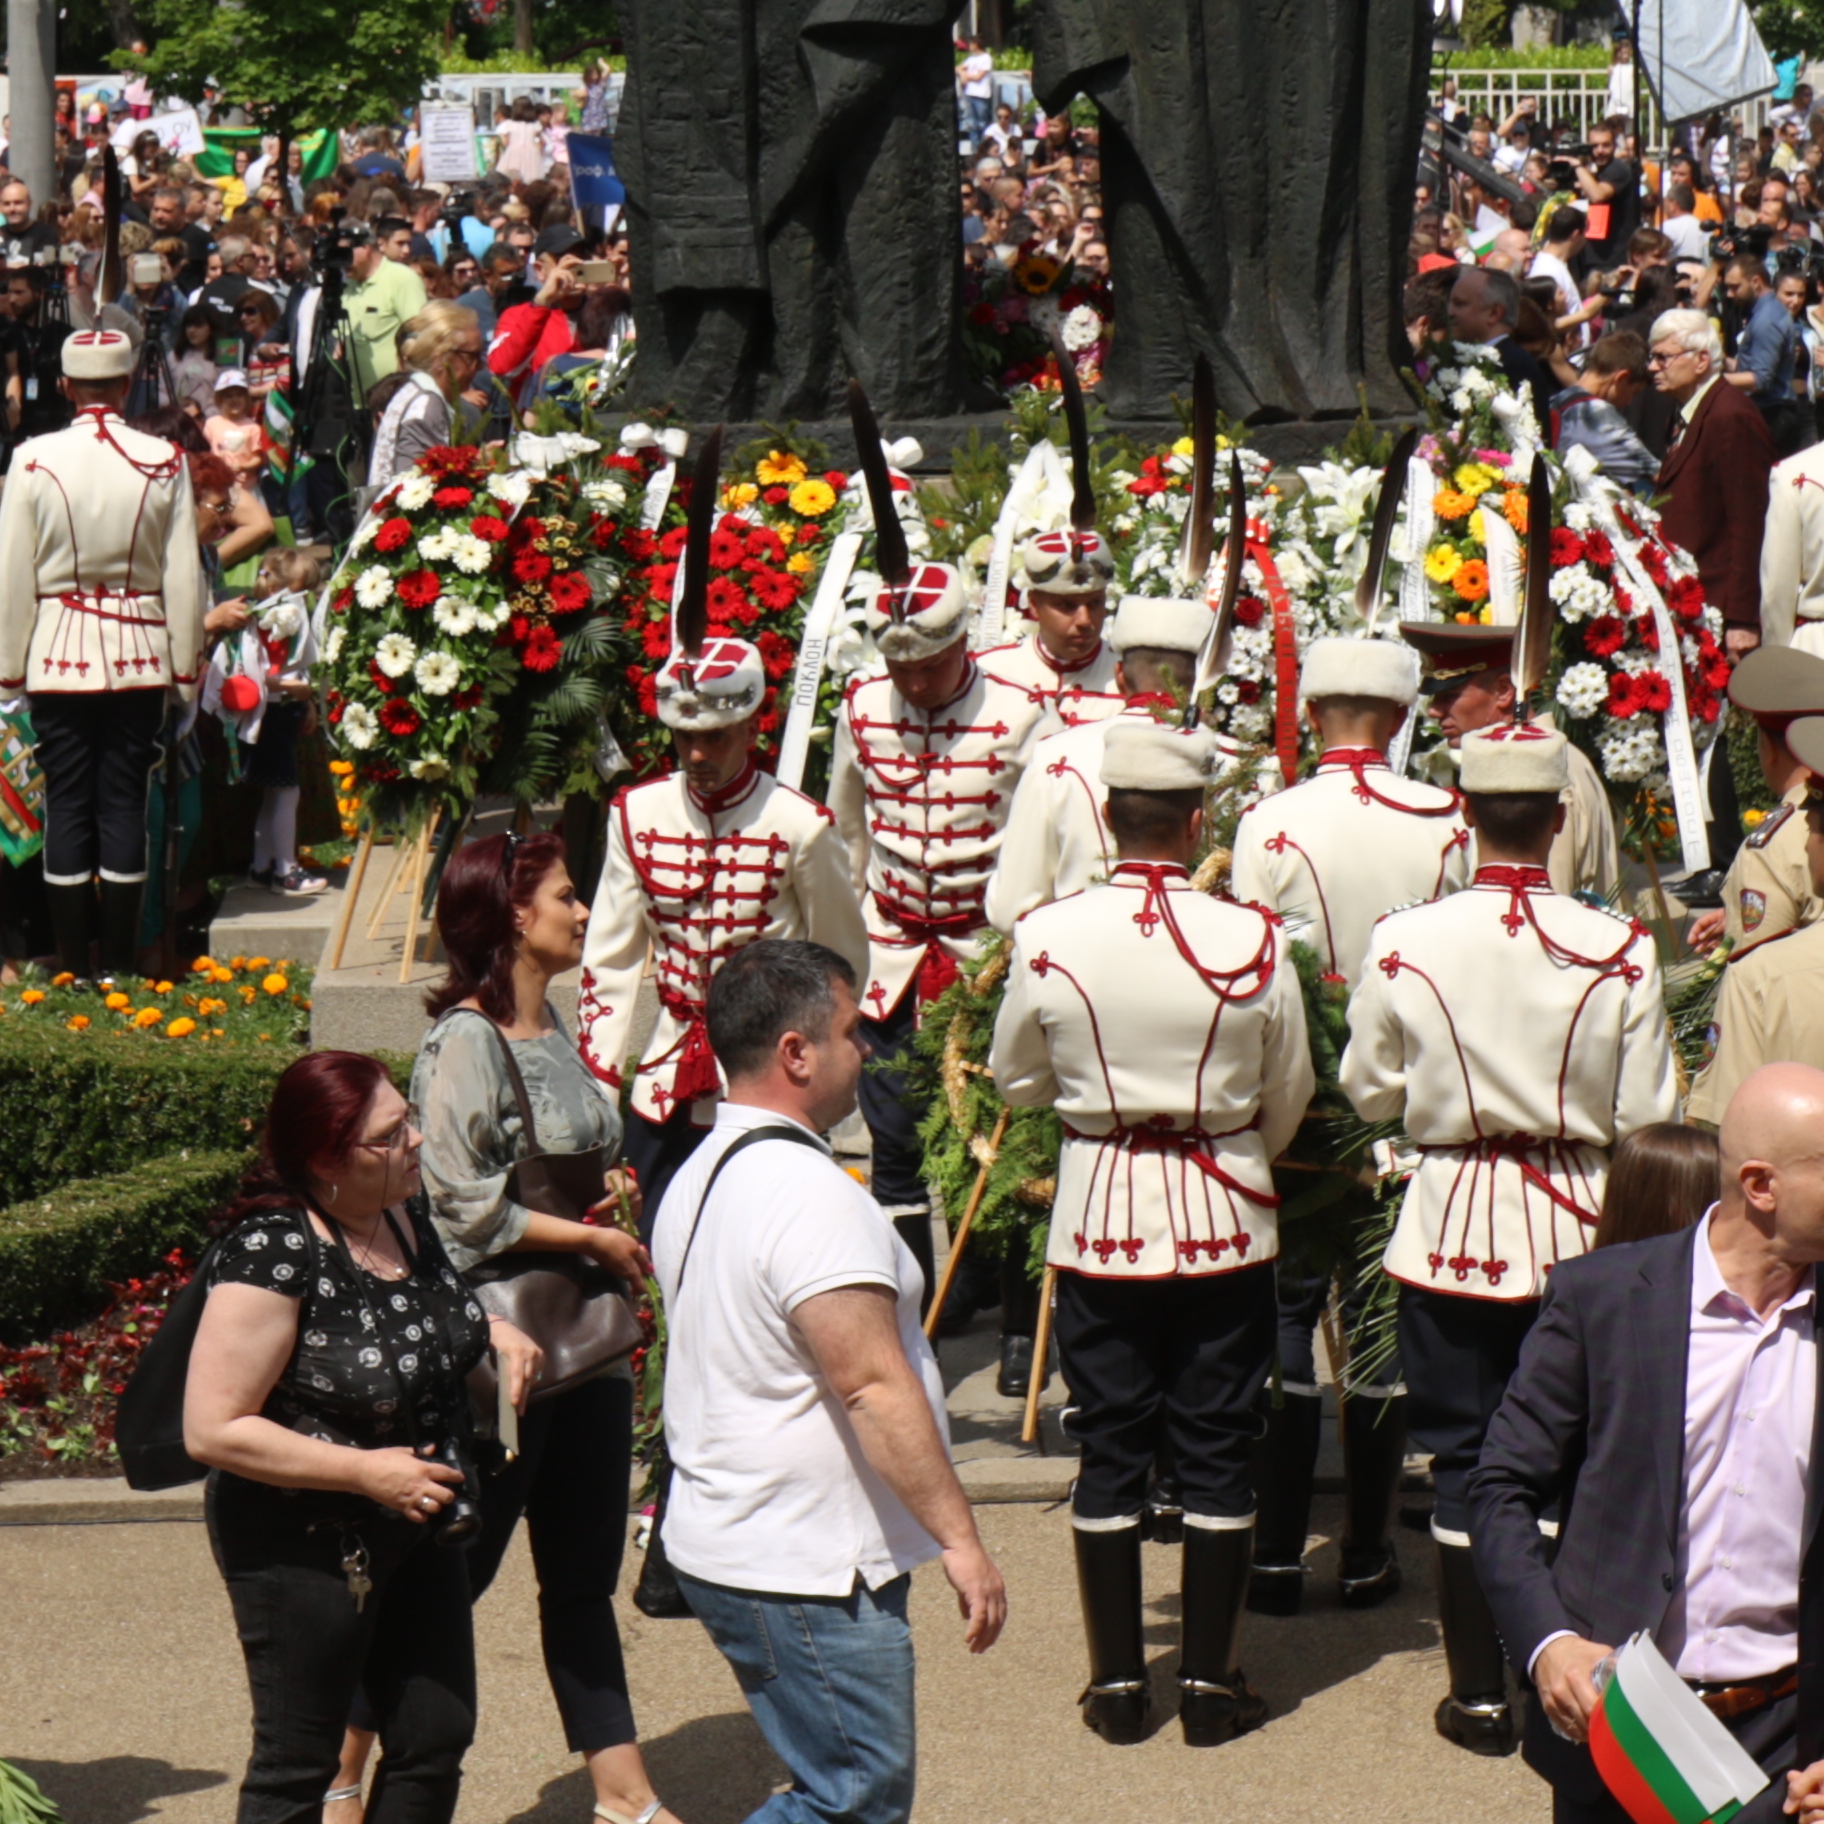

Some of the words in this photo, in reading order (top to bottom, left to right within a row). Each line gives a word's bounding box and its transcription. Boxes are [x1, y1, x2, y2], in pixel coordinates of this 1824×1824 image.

[573, 164, 605, 179] роф.
[984, 558, 1006, 648] РИЗНАТЕЛНОСТ
[795, 638, 823, 707] ПОКЛОН
